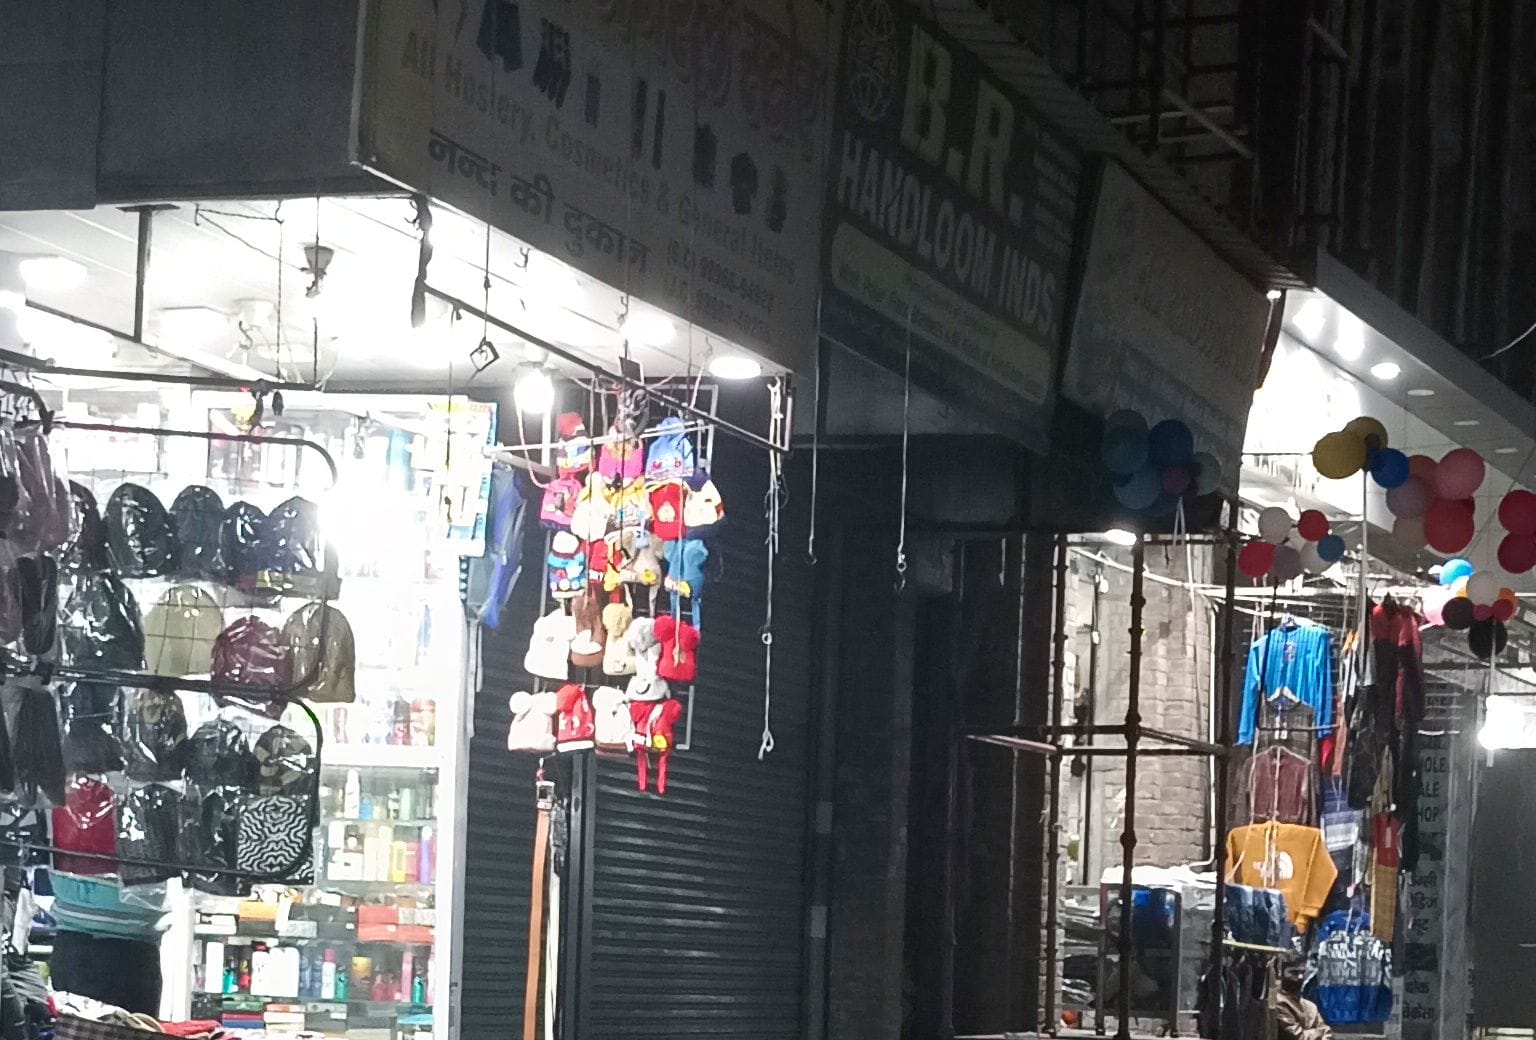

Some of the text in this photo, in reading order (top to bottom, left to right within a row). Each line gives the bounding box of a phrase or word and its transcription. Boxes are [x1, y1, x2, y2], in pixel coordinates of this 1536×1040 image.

[510, 172, 556, 225] की
[564, 202, 654, 273] दुकान
[838, 130, 999, 300] HANDLOOM
